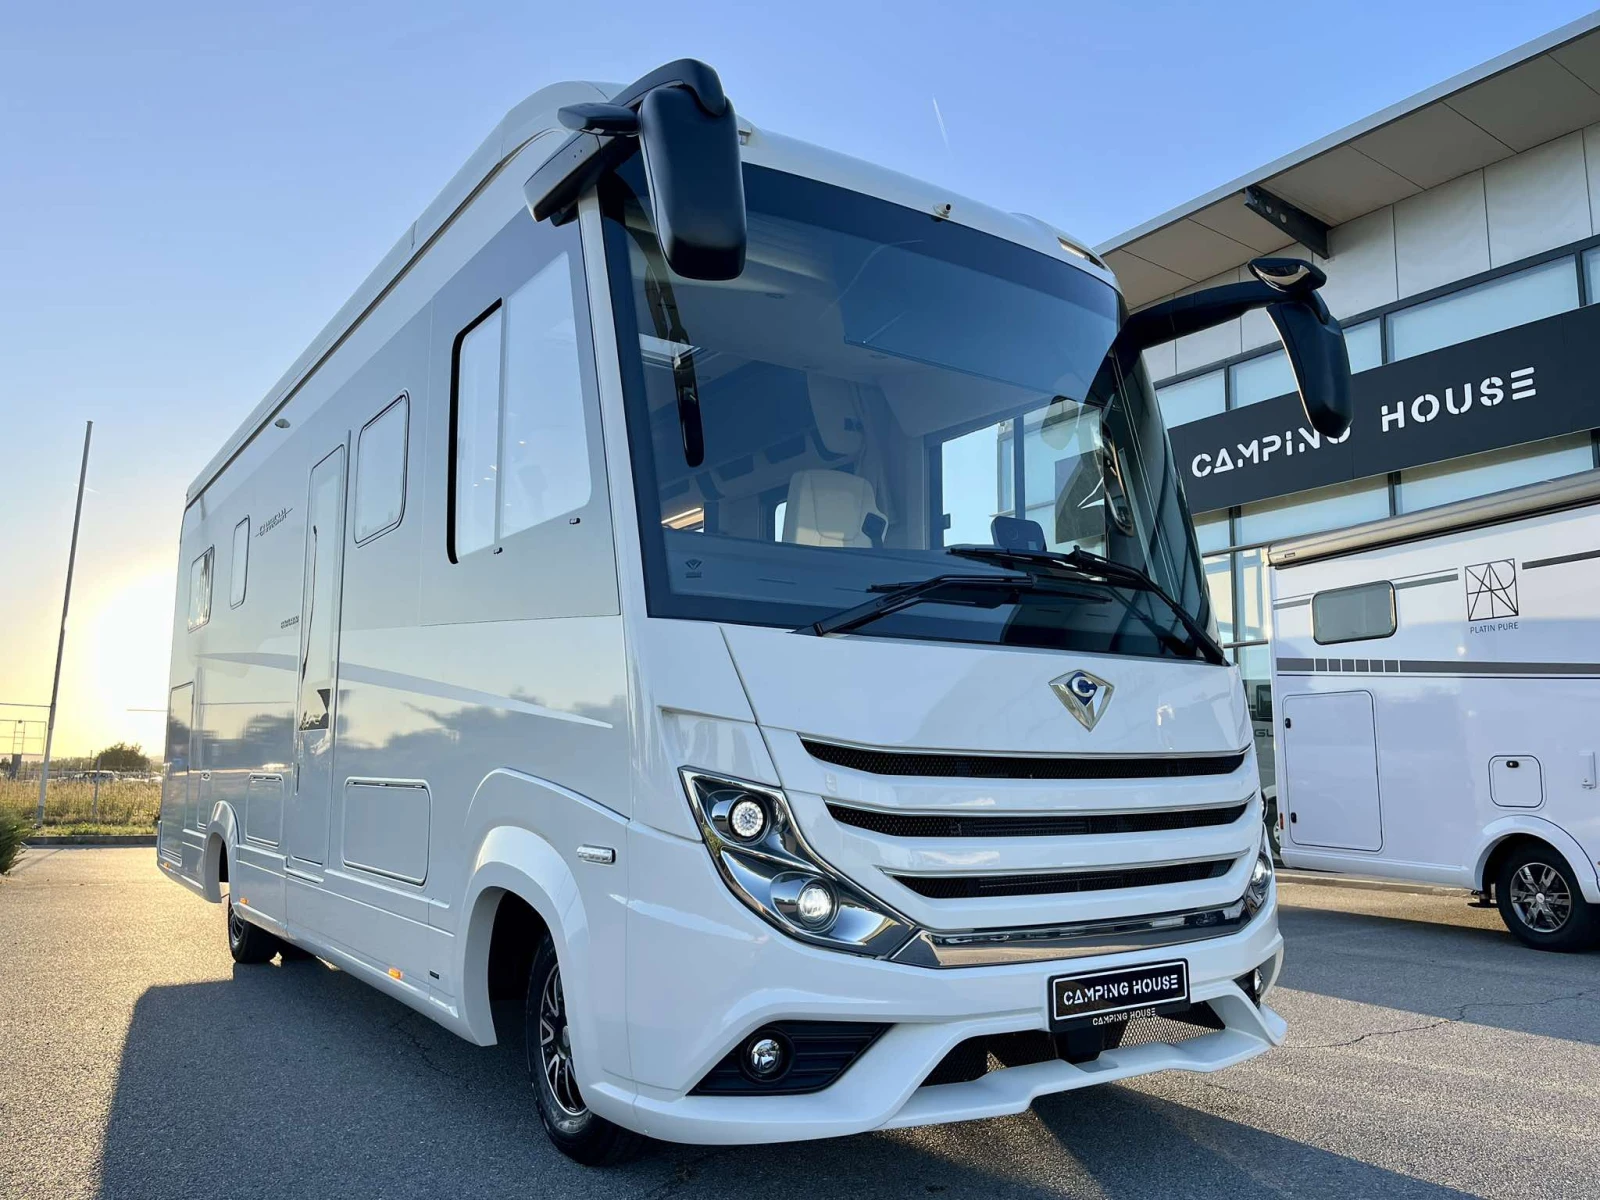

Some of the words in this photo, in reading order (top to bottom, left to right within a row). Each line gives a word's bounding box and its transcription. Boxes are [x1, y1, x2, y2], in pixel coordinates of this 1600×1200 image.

[1381, 366, 1537, 433] HOUSE
[1469, 624, 1496, 634] PLATIN
[1497, 621, 1519, 631] PURE
[1063, 981, 1129, 1006] CAMPING
[1133, 974, 1179, 995] HOUSE
[1092, 1012, 1128, 1026] CAMPING
[1129, 1007, 1156, 1020] HOUSE
